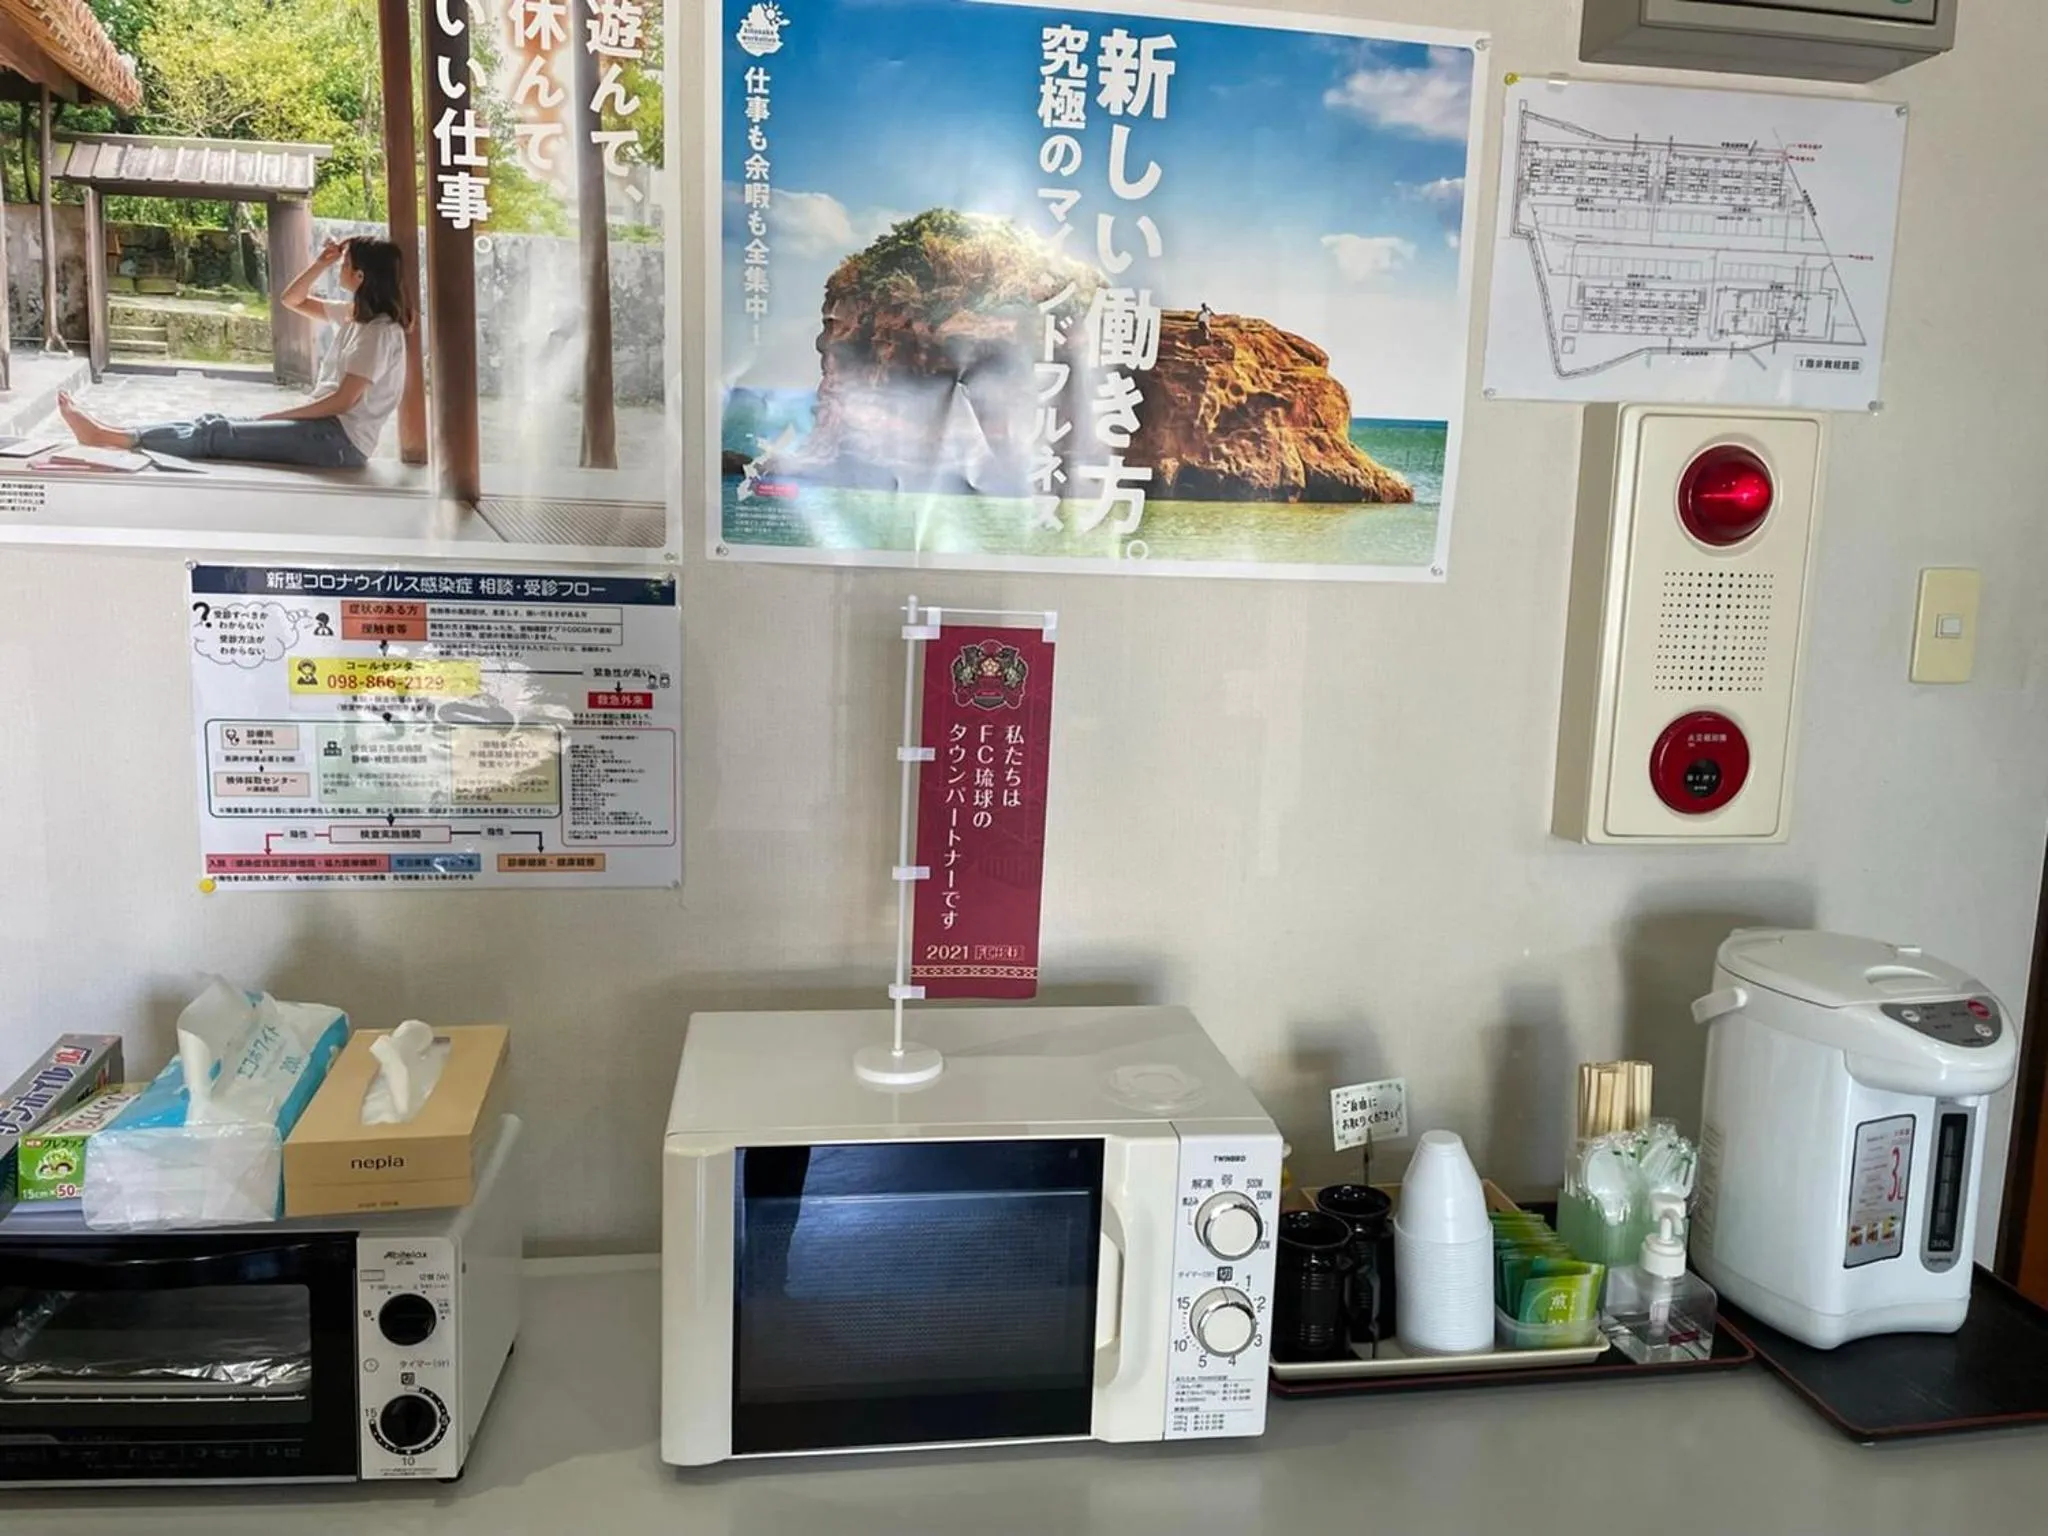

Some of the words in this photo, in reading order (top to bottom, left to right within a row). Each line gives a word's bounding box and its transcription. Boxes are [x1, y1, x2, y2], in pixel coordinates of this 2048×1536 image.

[586, 0, 644, 202] 遊んで、
[433, 0, 493, 253] いい仕事。
[1026, 24, 1089, 532] 究極のマインドフルネス
[1077, 28, 1178, 561] 新しい働き方。
[267, 572, 473, 595] 新型コロナウイルス感染症
[479, 578, 606, 597] 相談・受診フロー
[214, 611, 269, 620] 受診すべきか
[350, 604, 418, 616] 症状のある方
[219, 621, 264, 630] わからない
[362, 622, 407, 635] 接触者等
[219, 634, 264, 644] 受診方法が
[220, 646, 265, 656] わからない
[346, 661, 426, 671] コールセンター
[593, 667, 651, 678] 緊急性が高い
[327, 674, 444, 690] 098-866-2129
[597, 695, 644, 706] 救急外来
[1002, 724, 1024, 807] 私たちは
[972, 725, 995, 828] FC琉球の
[940, 723, 968, 930] タウンパートナーです
[360, 829, 422, 840] 検査実施機関
[927, 946, 969, 960] 2021
[1342, 1096, 1377, 1114] ご自由に
[1342, 1110, 1398, 1131] お取りください
[351, 1155, 405, 1170] nepia
[1177, 1297, 1190, 1309] 15
[1258, 1296, 1266, 1308] 2
[1174, 1339, 1188, 1352] 10
[1254, 1334, 1263, 1347] 3
[1198, 1356, 1207, 1368] 5
[1228, 1354, 1236, 1367] 4
[365, 1408, 377, 1418] 15
[402, 1457, 415, 1467] 10
